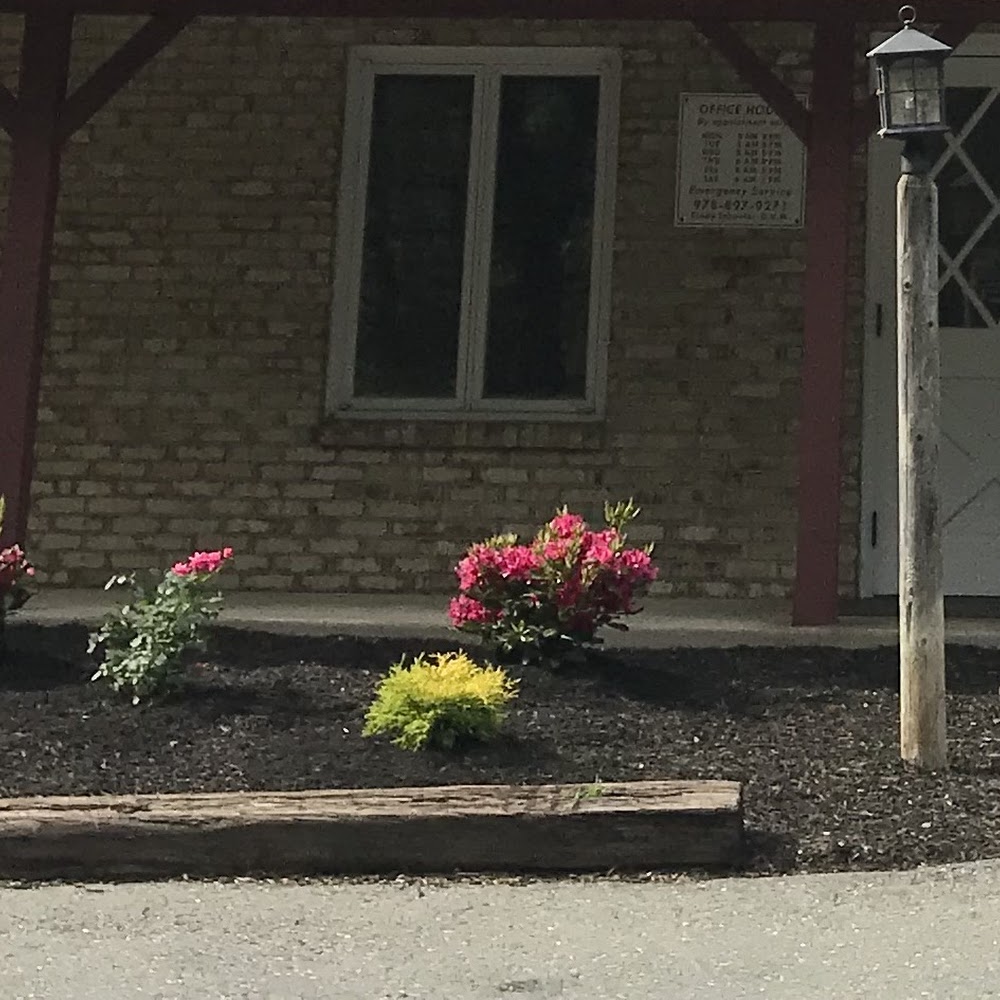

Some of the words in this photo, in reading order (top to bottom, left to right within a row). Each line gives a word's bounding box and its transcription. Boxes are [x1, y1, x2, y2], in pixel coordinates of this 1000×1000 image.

[699, 104, 743, 115] OFFICE
[746, 104, 773, 115] HOU
[689, 185, 747, 198] Emergency
